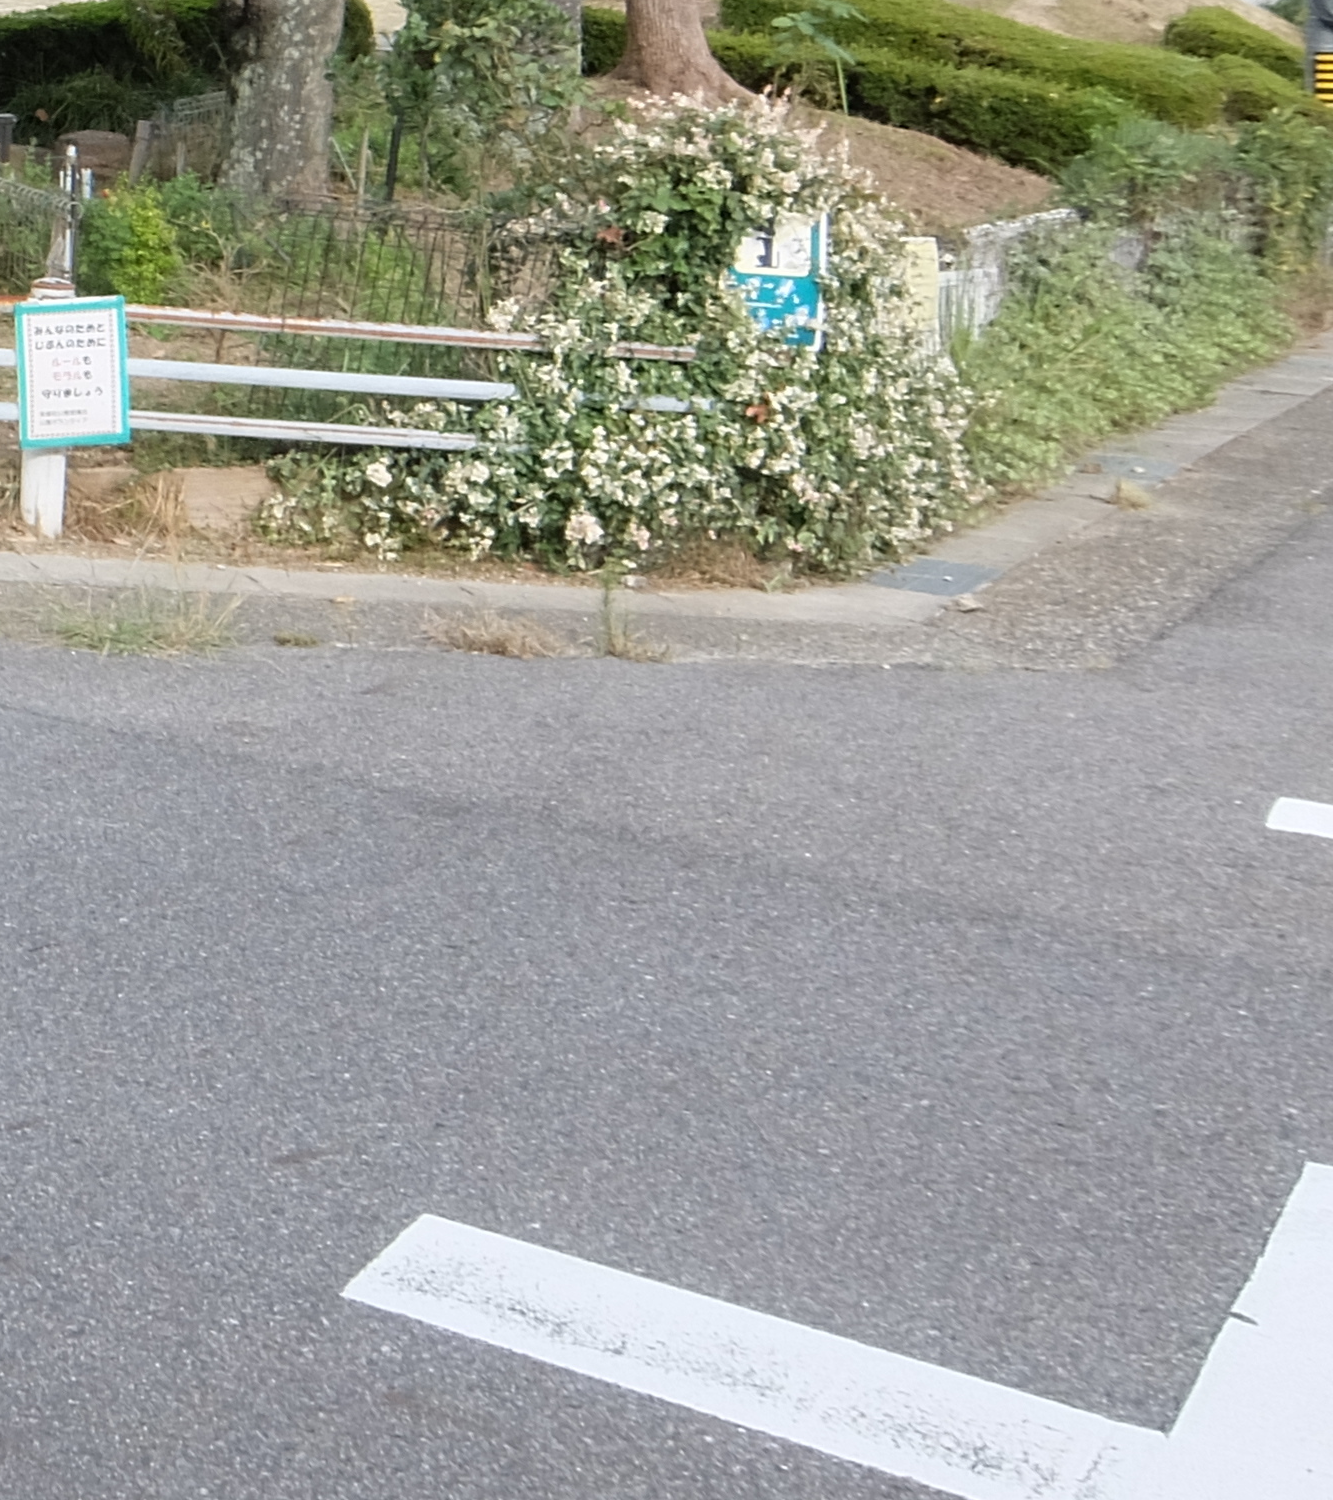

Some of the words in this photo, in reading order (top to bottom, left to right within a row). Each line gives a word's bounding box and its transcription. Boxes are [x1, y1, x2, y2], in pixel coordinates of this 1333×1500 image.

[34, 323, 105, 336] みんなのためと
[35, 338, 106, 350] じぶんのために
[52, 355, 92, 366] ルールも
[53, 369, 93, 381] モラルも
[42, 386, 103, 399] 守りましょう
